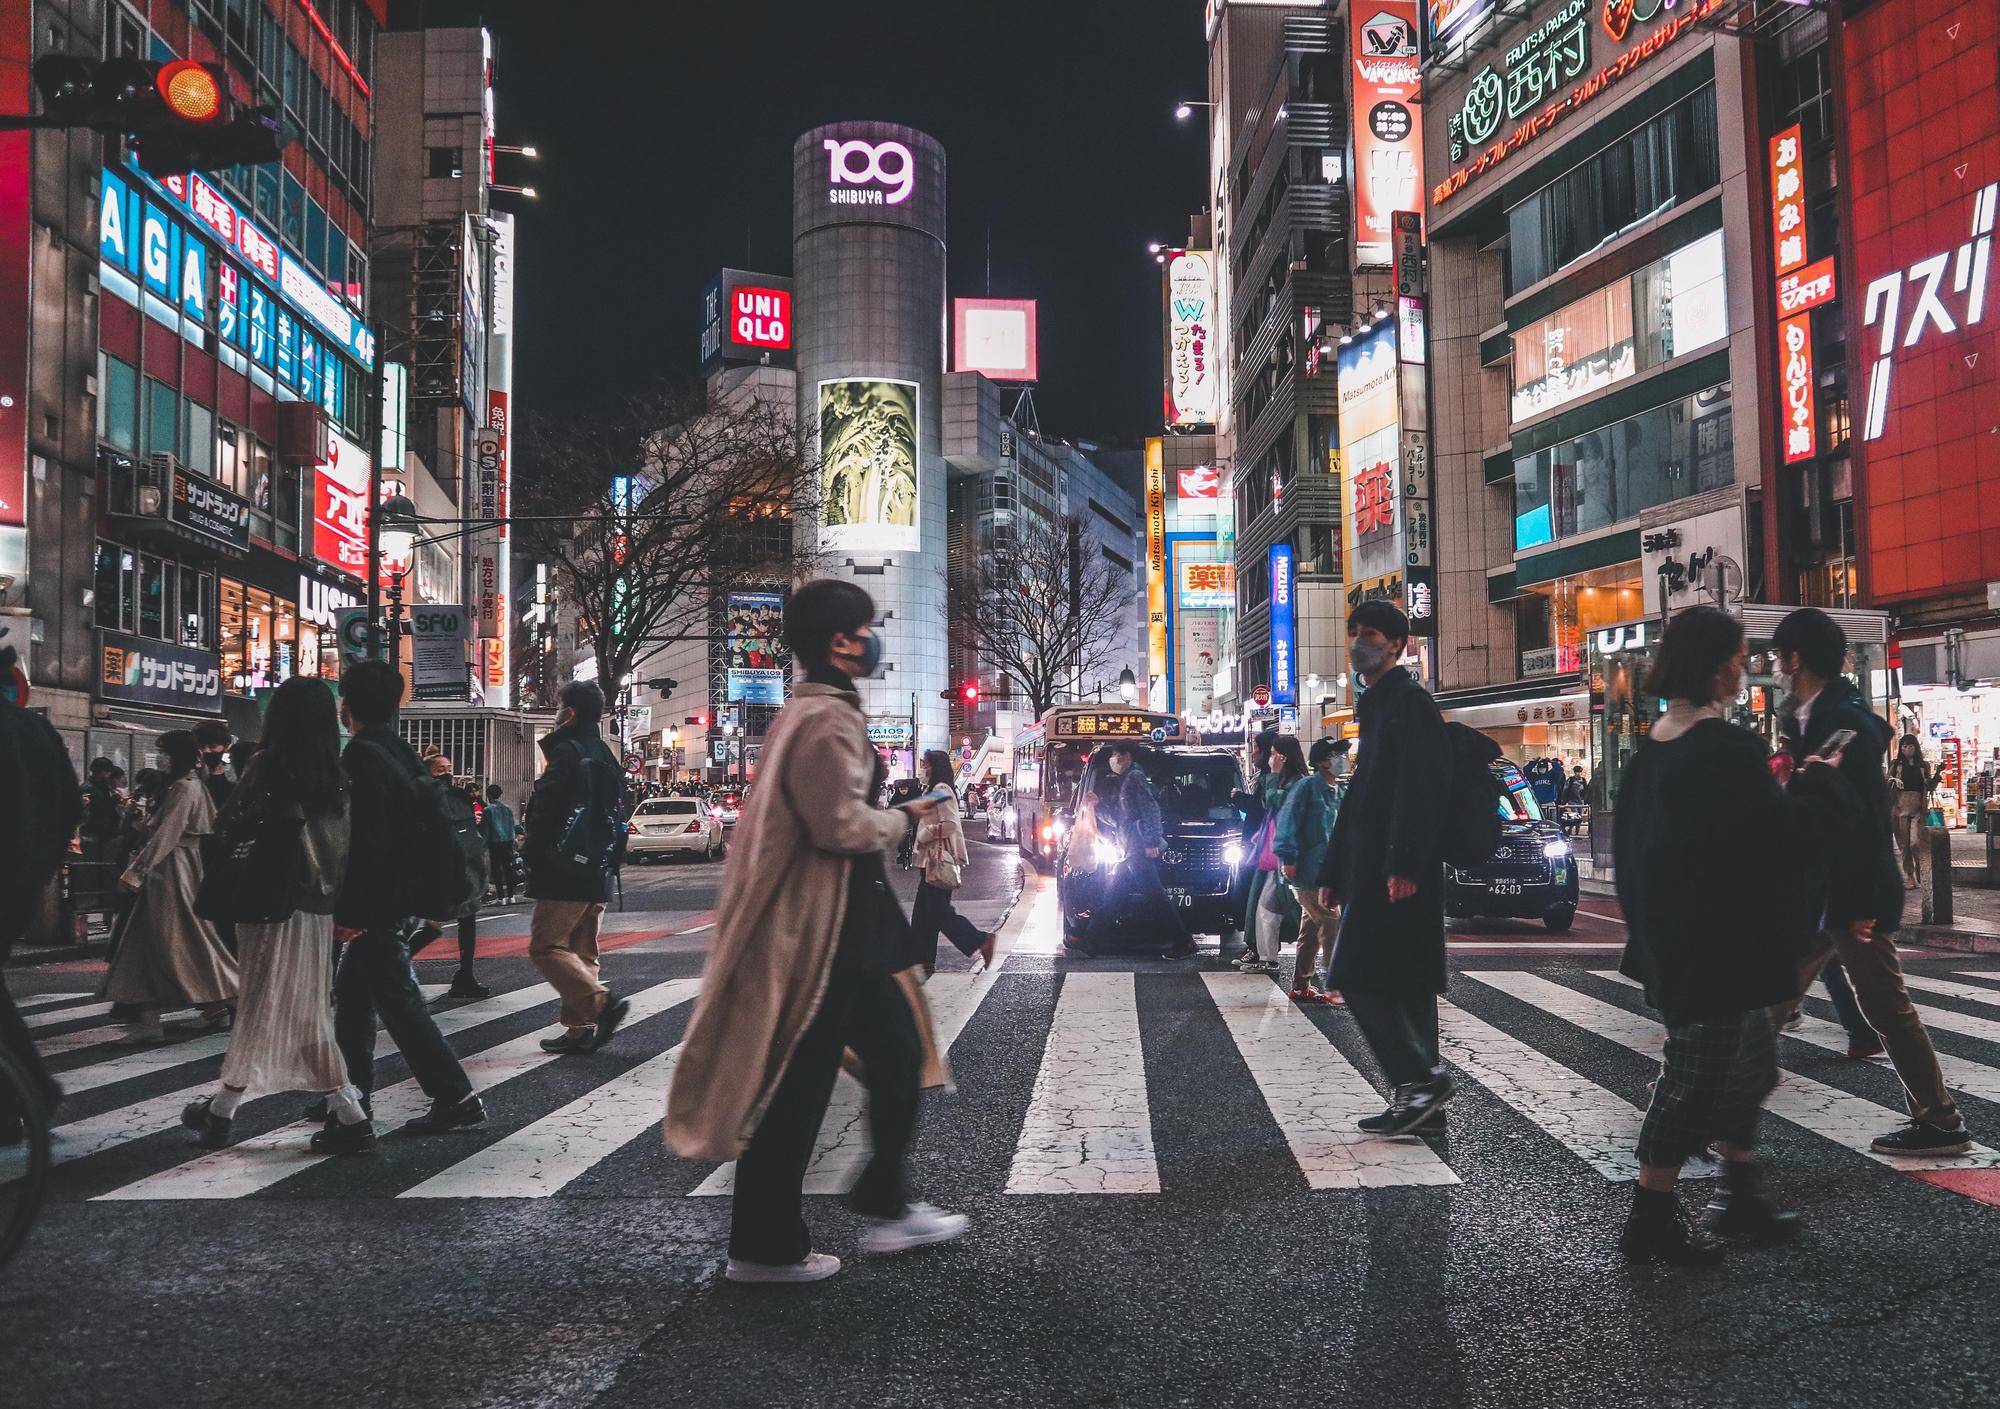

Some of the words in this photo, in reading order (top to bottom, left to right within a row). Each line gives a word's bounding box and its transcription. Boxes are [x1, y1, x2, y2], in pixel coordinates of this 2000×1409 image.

[1506, 35, 1538, 67] FRUITS
[1537, 31, 1547, 45] &
[1507, 17, 1587, 119] 西村
[1448, 112, 1463, 162] 渋谷
[824, 139, 914, 204] 109
[829, 189, 883, 205] SHIBUYA
[100, 186, 204, 310] AGA
[706, 287, 718, 325] THE
[738, 292, 780, 318] UNI
[1173, 299, 1206, 322] W
[354, 327, 375, 365] 4F
[738, 316, 784, 342] QLO
[1342, 375, 1383, 405] Matsumoto
[1416, 445, 1425, 479] フルーツ
[186, 482, 240, 523] サンドラッグ
[1151, 468, 1160, 508] KiYoshi
[1354, 460, 1395, 537] 薬
[189, 510, 205, 526] DRUG
[1408, 517, 1418, 551] フルーツ
[1151, 509, 1161, 572] Matsumoto
[1188, 564, 1218, 591] 薬
[1277, 555, 1289, 605] MIZUHO
[299, 574, 357, 629] LUS
[141, 656, 219, 697] サンドラッグ
[1277, 639, 1289, 692] みずほ銀行
[1494, 884, 1521, 895] 62-03
